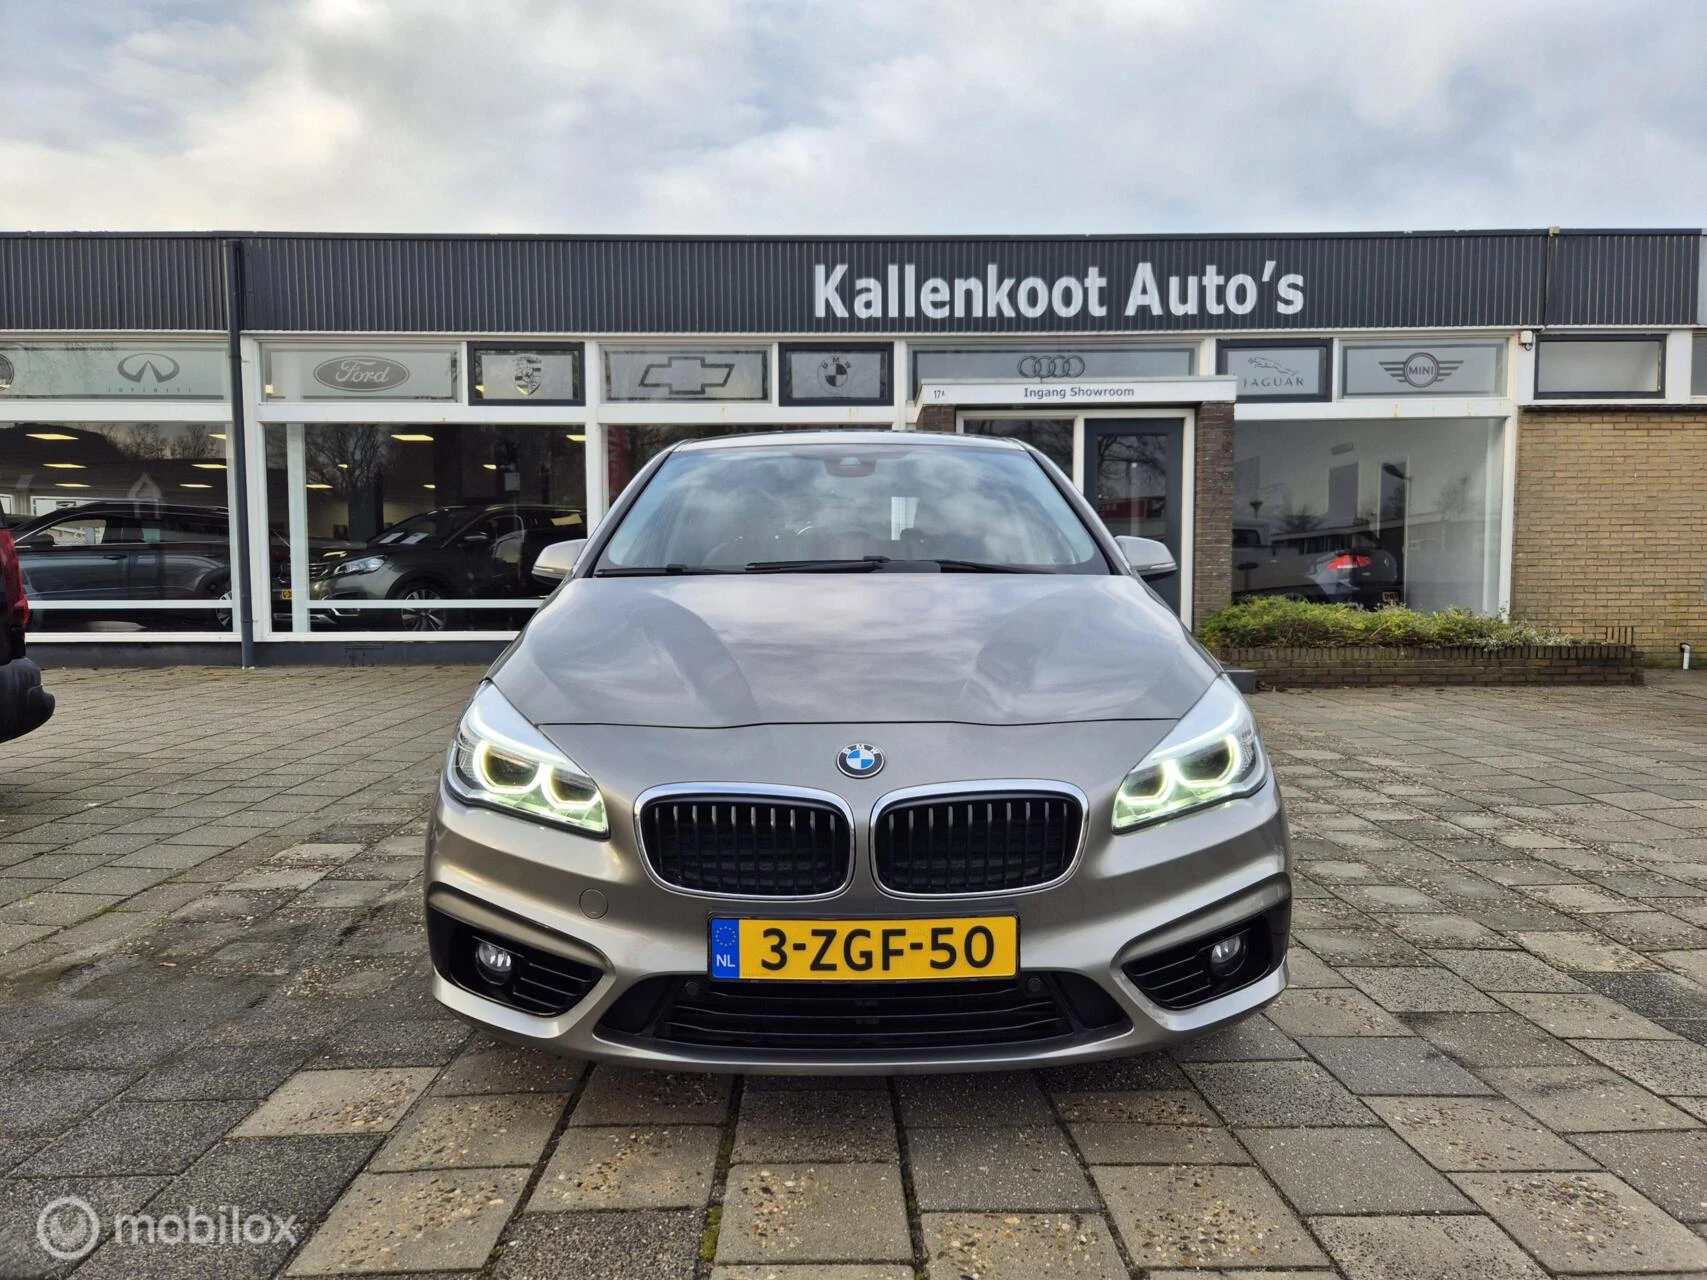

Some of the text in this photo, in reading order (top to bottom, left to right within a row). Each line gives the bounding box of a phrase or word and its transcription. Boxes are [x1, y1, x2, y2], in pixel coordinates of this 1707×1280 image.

[814, 261, 1305, 318] Kallenkoot Auto's
[335, 360, 391, 382] Ford
[1408, 366, 1434, 375] MINI
[1243, 377, 1304, 388] JAGUAR
[1024, 386, 1135, 399] Ingang Showroom
[761, 925, 995, 971] 3-ZGF-50
[716, 953, 735, 967] NL
